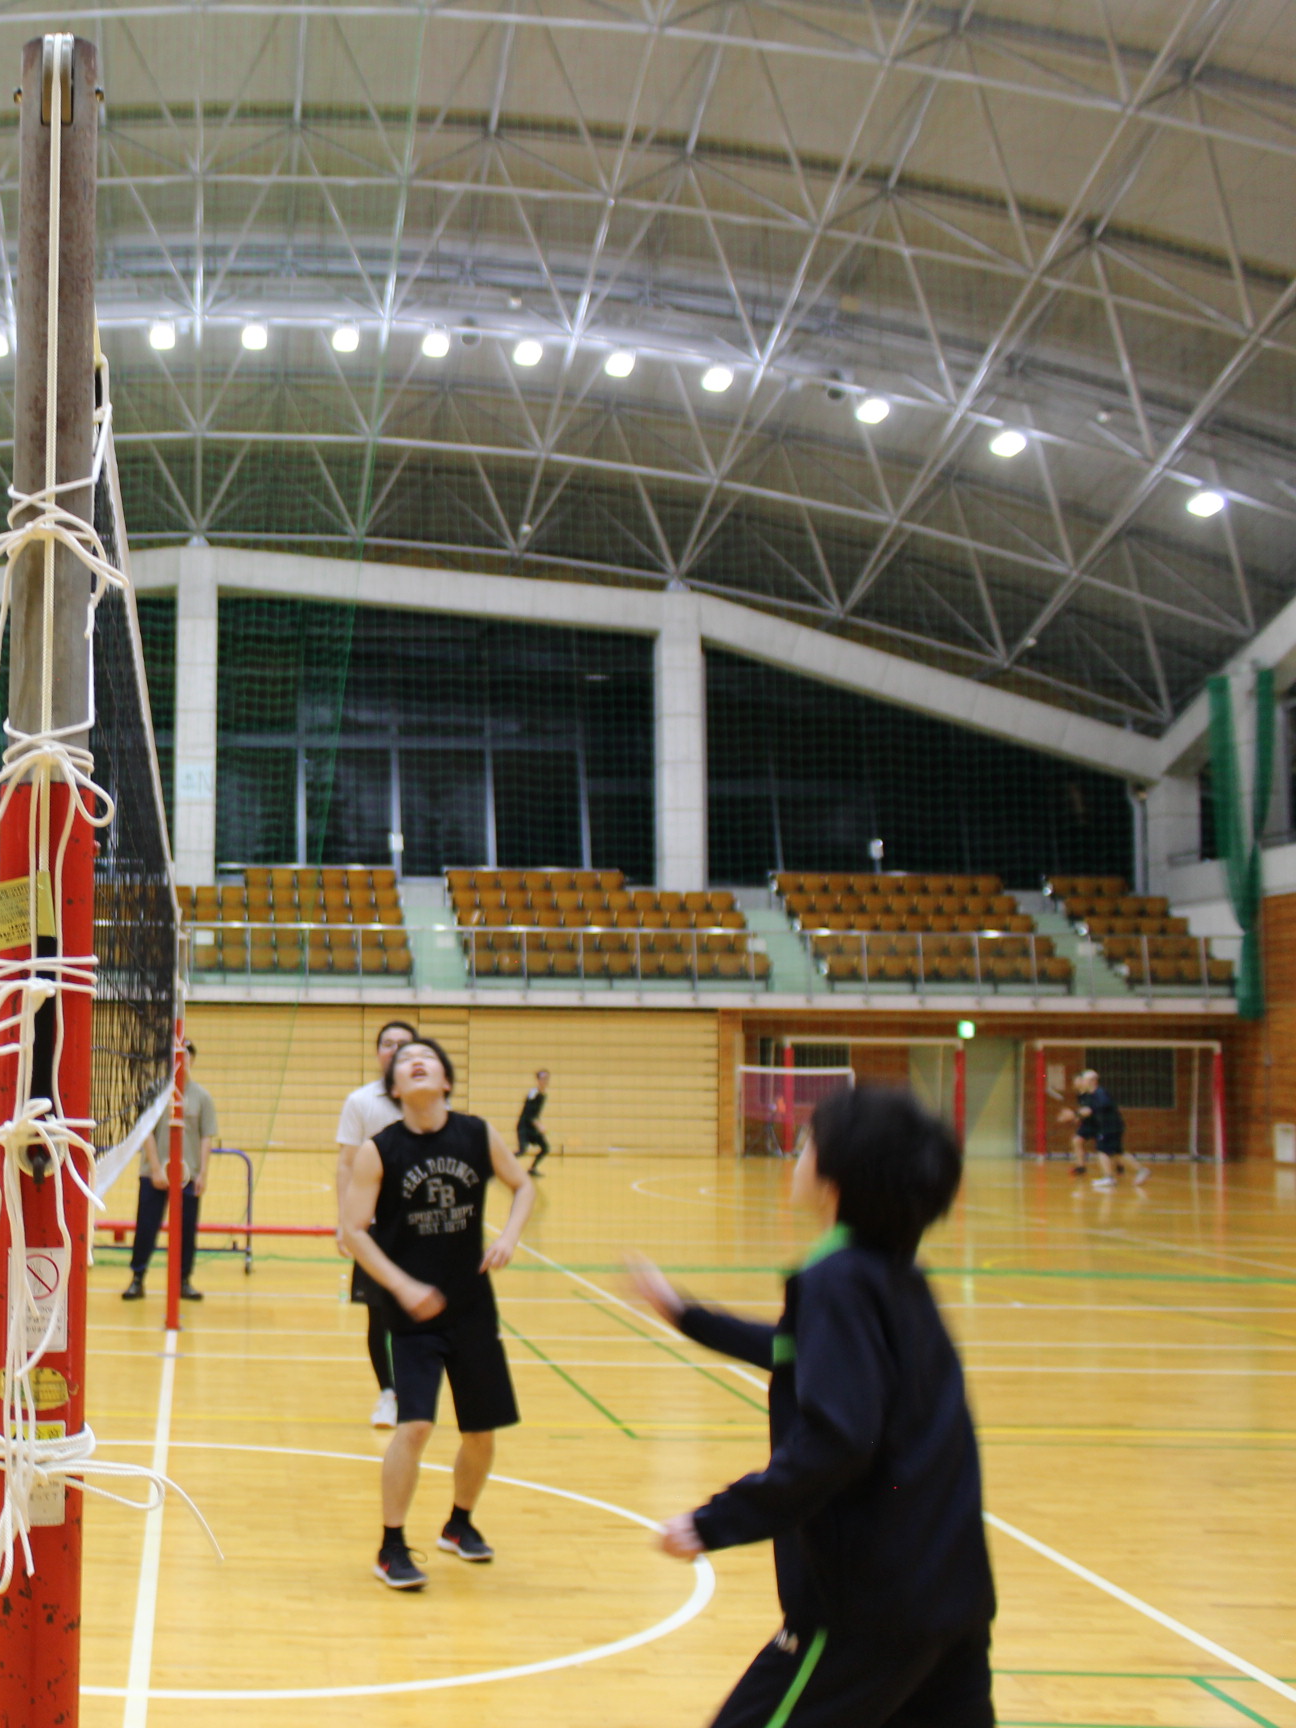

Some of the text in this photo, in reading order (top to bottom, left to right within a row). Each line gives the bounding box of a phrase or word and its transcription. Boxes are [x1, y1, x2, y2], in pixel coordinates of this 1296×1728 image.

[402, 1165, 429, 1199] FEEL
[427, 1178, 456, 1208] FB
[408, 1210, 447, 1225] SPORTS
